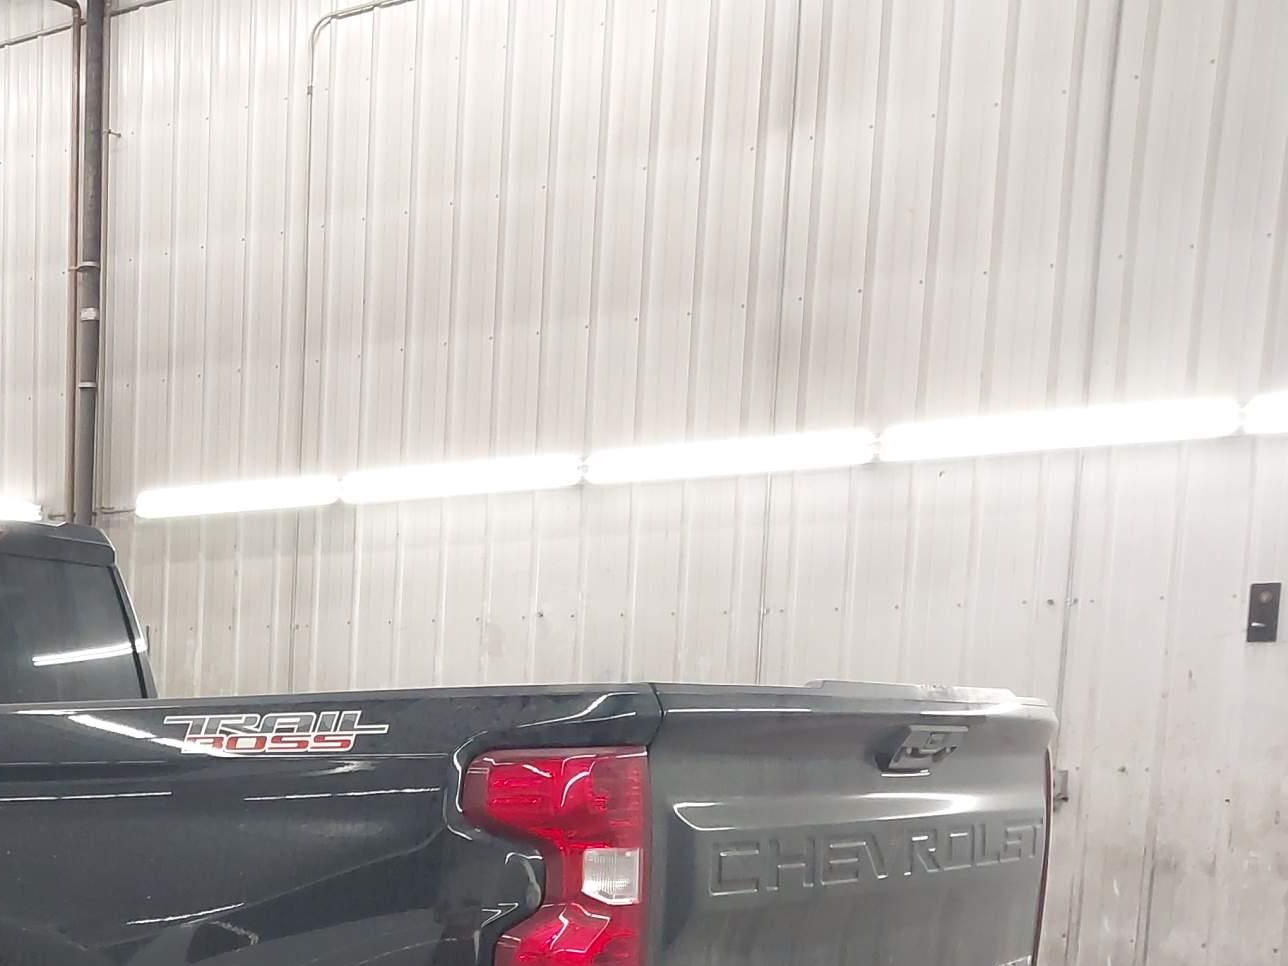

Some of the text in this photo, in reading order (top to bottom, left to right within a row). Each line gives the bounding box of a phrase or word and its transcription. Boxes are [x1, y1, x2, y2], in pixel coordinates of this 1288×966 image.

[163, 710, 389, 736] TRAIL
[181, 734, 357, 754] BOSS
[709, 818, 1044, 896] CHEVROLET
